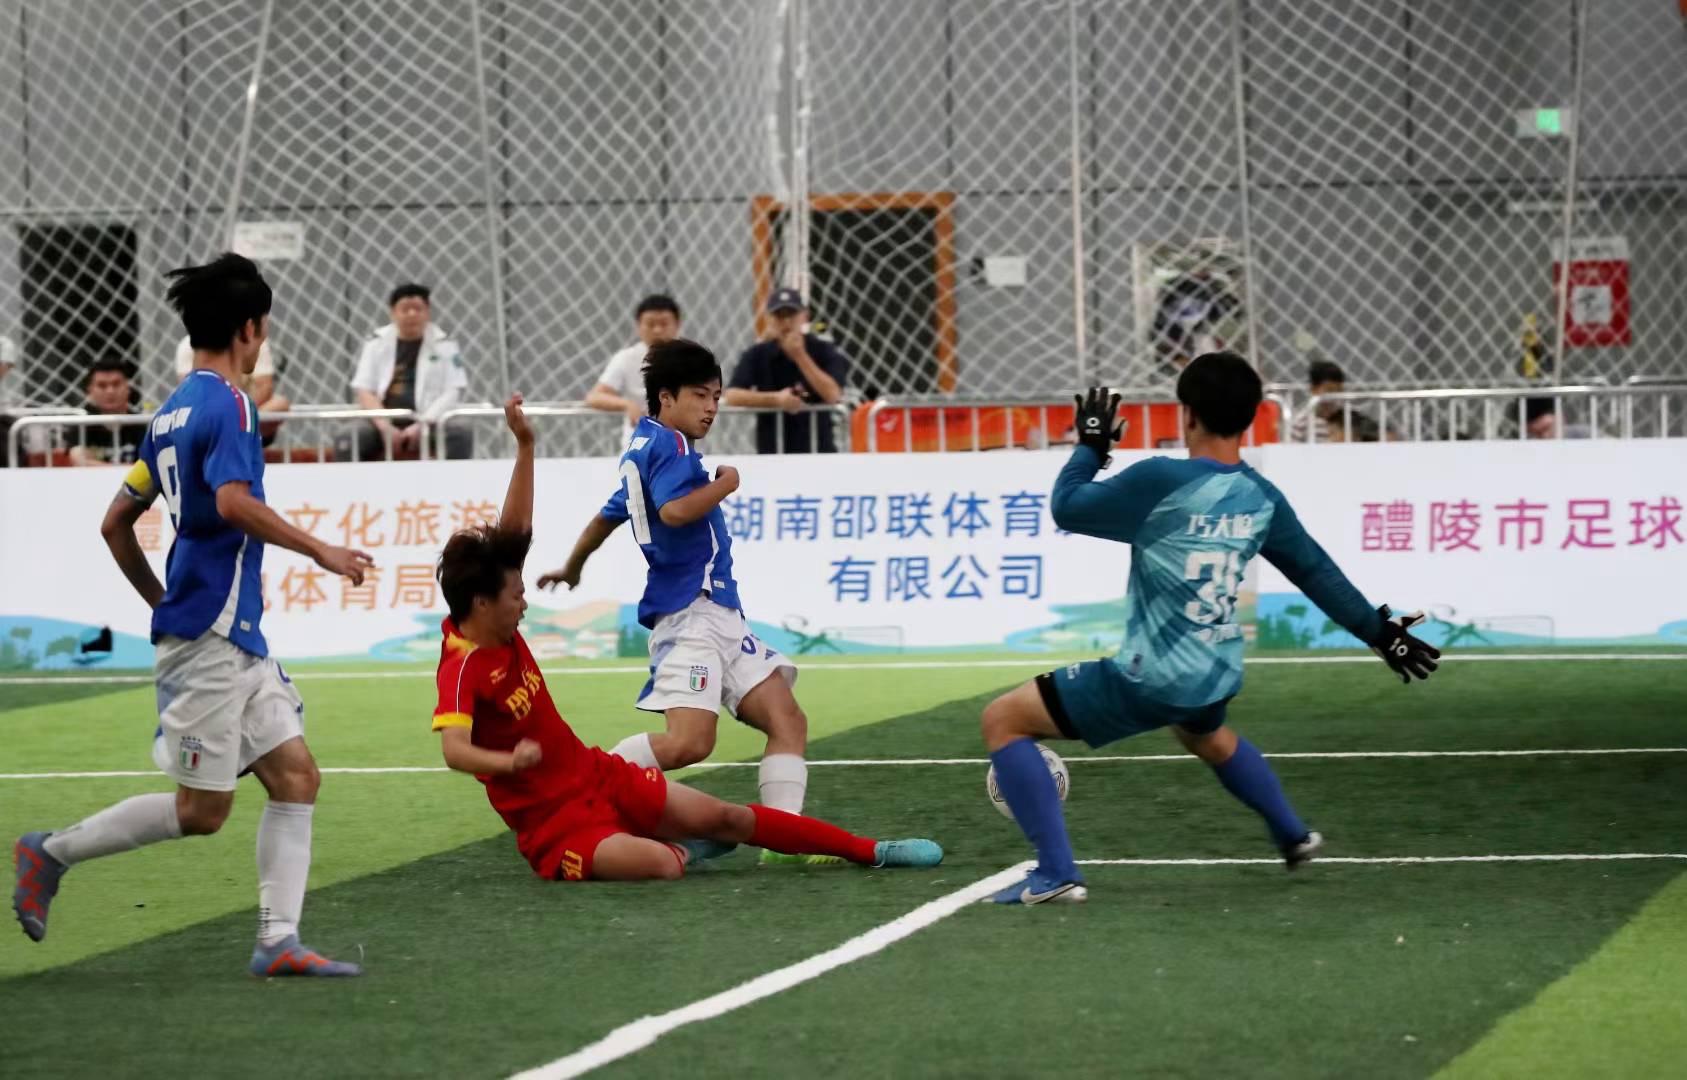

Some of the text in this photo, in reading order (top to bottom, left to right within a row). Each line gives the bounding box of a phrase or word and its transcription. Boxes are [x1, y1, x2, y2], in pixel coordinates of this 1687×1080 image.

[133, 499, 498, 546] 文化旅游
[723, 490, 1072, 541] 湖南邵联体育
[1361, 497, 1684, 551] 醴陵市足球
[262, 565, 436, 610] 体育局
[828, 554, 1042, 600] 有限公司
